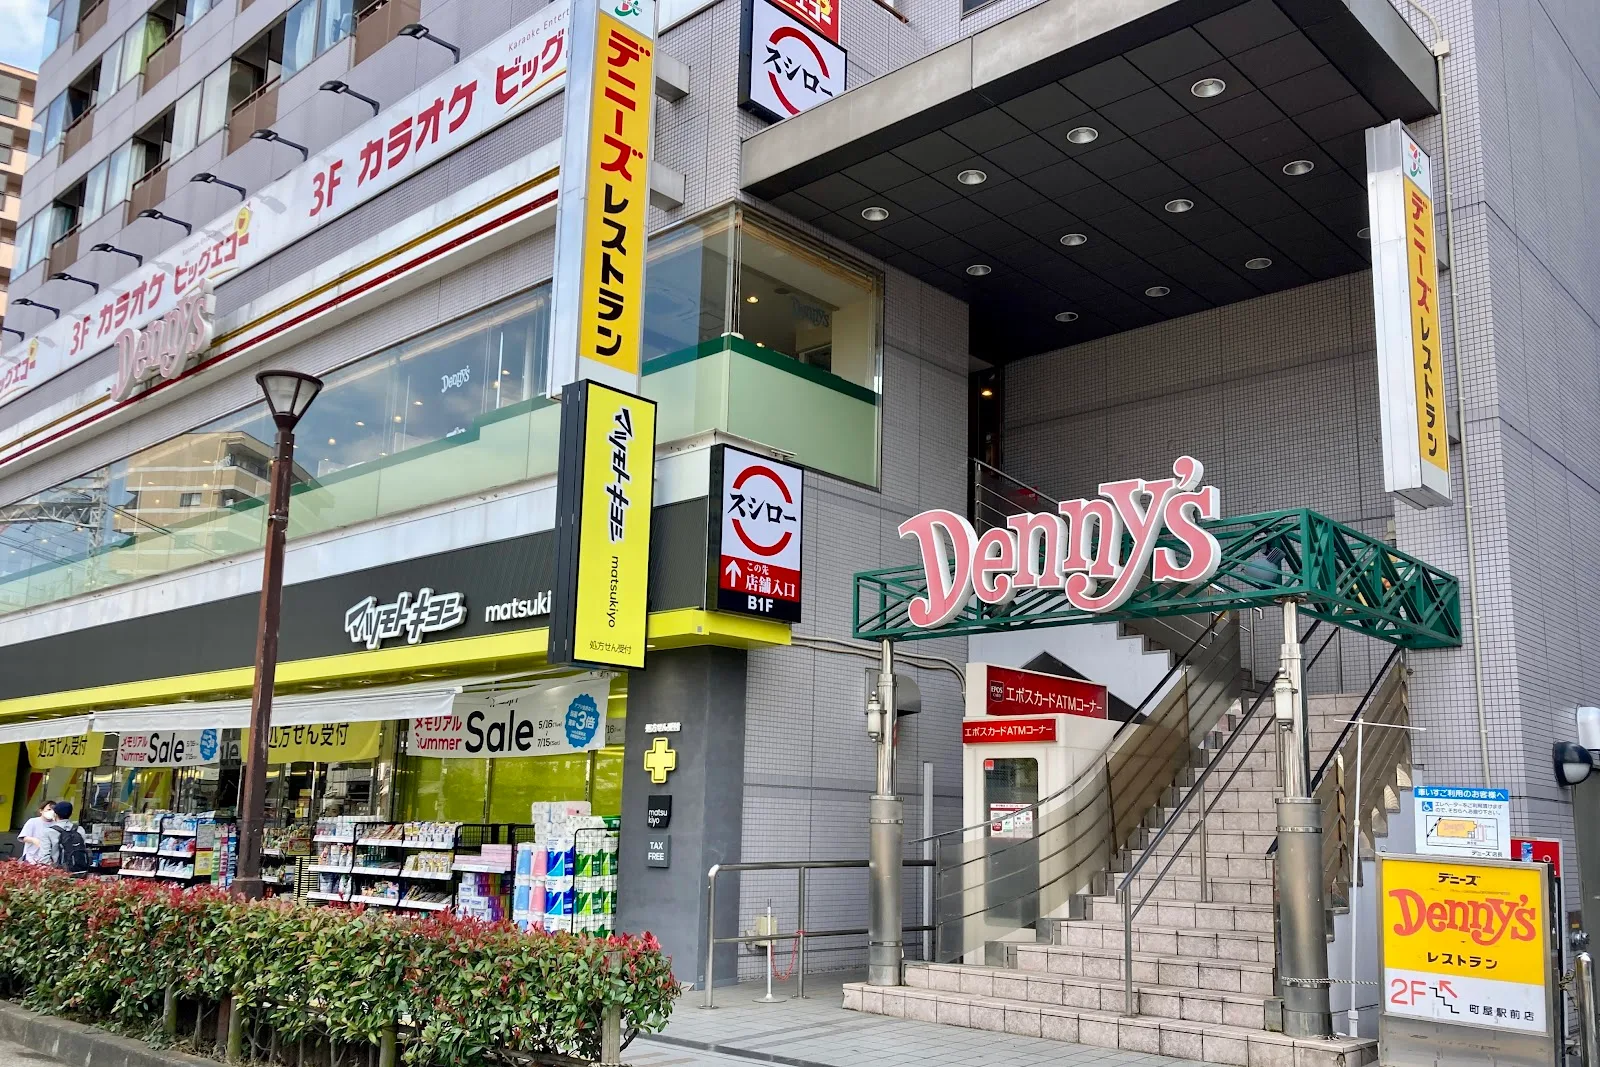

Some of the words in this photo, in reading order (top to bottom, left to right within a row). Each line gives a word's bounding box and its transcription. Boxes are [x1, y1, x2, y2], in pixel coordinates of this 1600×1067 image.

[508, 28, 540, 52] Karaoke
[763, 45, 833, 98] スシロー
[601, 29, 650, 182] デニーズ
[309, 159, 343, 217] 3F
[357, 80, 478, 188] カラオケ
[495, 28, 569, 105] ビッグ
[1412, 190, 1432, 313] デニーズ
[596, 183, 629, 356] レストラン
[70, 314, 91, 355] 3F
[97, 272, 165, 339] カラオケ
[174, 231, 249, 295] ビッグエコー
[110, 278, 216, 402] Denny's
[441, 365, 470, 393] Denny's
[1421, 316, 1437, 456] レストラン
[605, 406, 633, 543] マツモトキヨシ
[728, 492, 797, 523] スシロー
[897, 455, 1222, 629] Denny's
[747, 562, 769, 575] この先
[608, 556, 619, 628] matsukiyo
[745, 574, 795, 598] 店舗入口
[485, 590, 552, 622] matsuki
[747, 595, 773, 613] B1F
[345, 587, 467, 650] マツモトキヨシ
[589, 640, 632, 655] 処方せん受付
[1006, 687, 1102, 713] エポスカードATMコーナー
[414, 716, 462, 731] メモリアル
[465, 710, 534, 753] Sale
[965, 725, 1052, 737] エポスカードATMコーナー
[147, 732, 185, 764] Sale
[1418, 788, 1505, 799] 車いすご利用のお客様へ
[648, 809, 668, 817] matsu
[648, 816, 660, 827] kiyo
[648, 852, 664, 861] FREE
[650, 842, 664, 850] TAX
[1439, 872, 1481, 886] デニーズ
[1389, 889, 1536, 946] Denny's
[1428, 952, 1497, 970] レストラン
[1391, 978, 1427, 1006] 2F
[1469, 1003, 1535, 1021] 町屋駅前店
